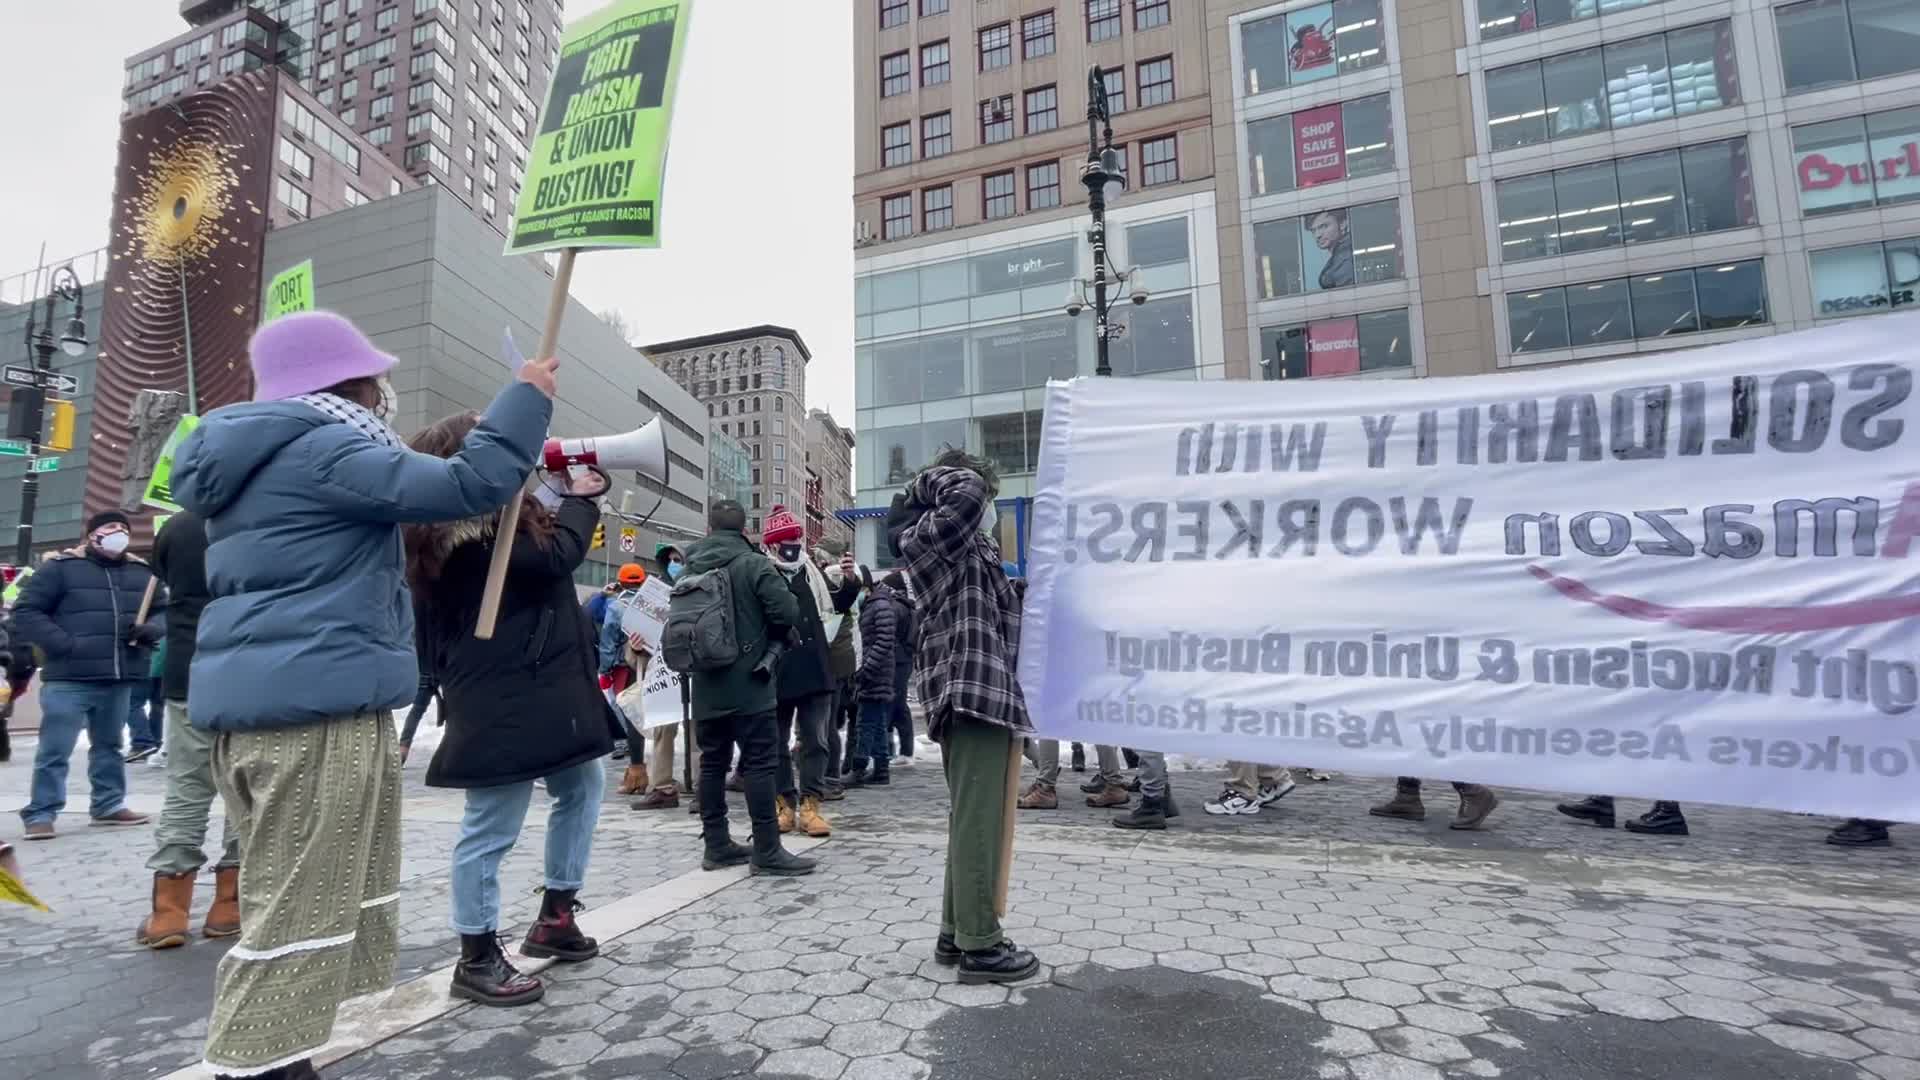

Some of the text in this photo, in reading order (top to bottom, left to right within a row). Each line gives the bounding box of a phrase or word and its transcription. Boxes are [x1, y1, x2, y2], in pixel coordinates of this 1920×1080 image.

[581, 33, 640, 86] FIGHT
[562, 73, 643, 127] RACISM
[1302, 121, 1335, 138] SHOP
[549, 112, 636, 165] & UNION
[1303, 137, 1336, 153] SAVE
[533, 159, 635, 211] BUSTING!
[616, 207, 650, 220] RACISM
[1007, 258, 1041, 273] brght
[644, 680, 668, 696] NION
